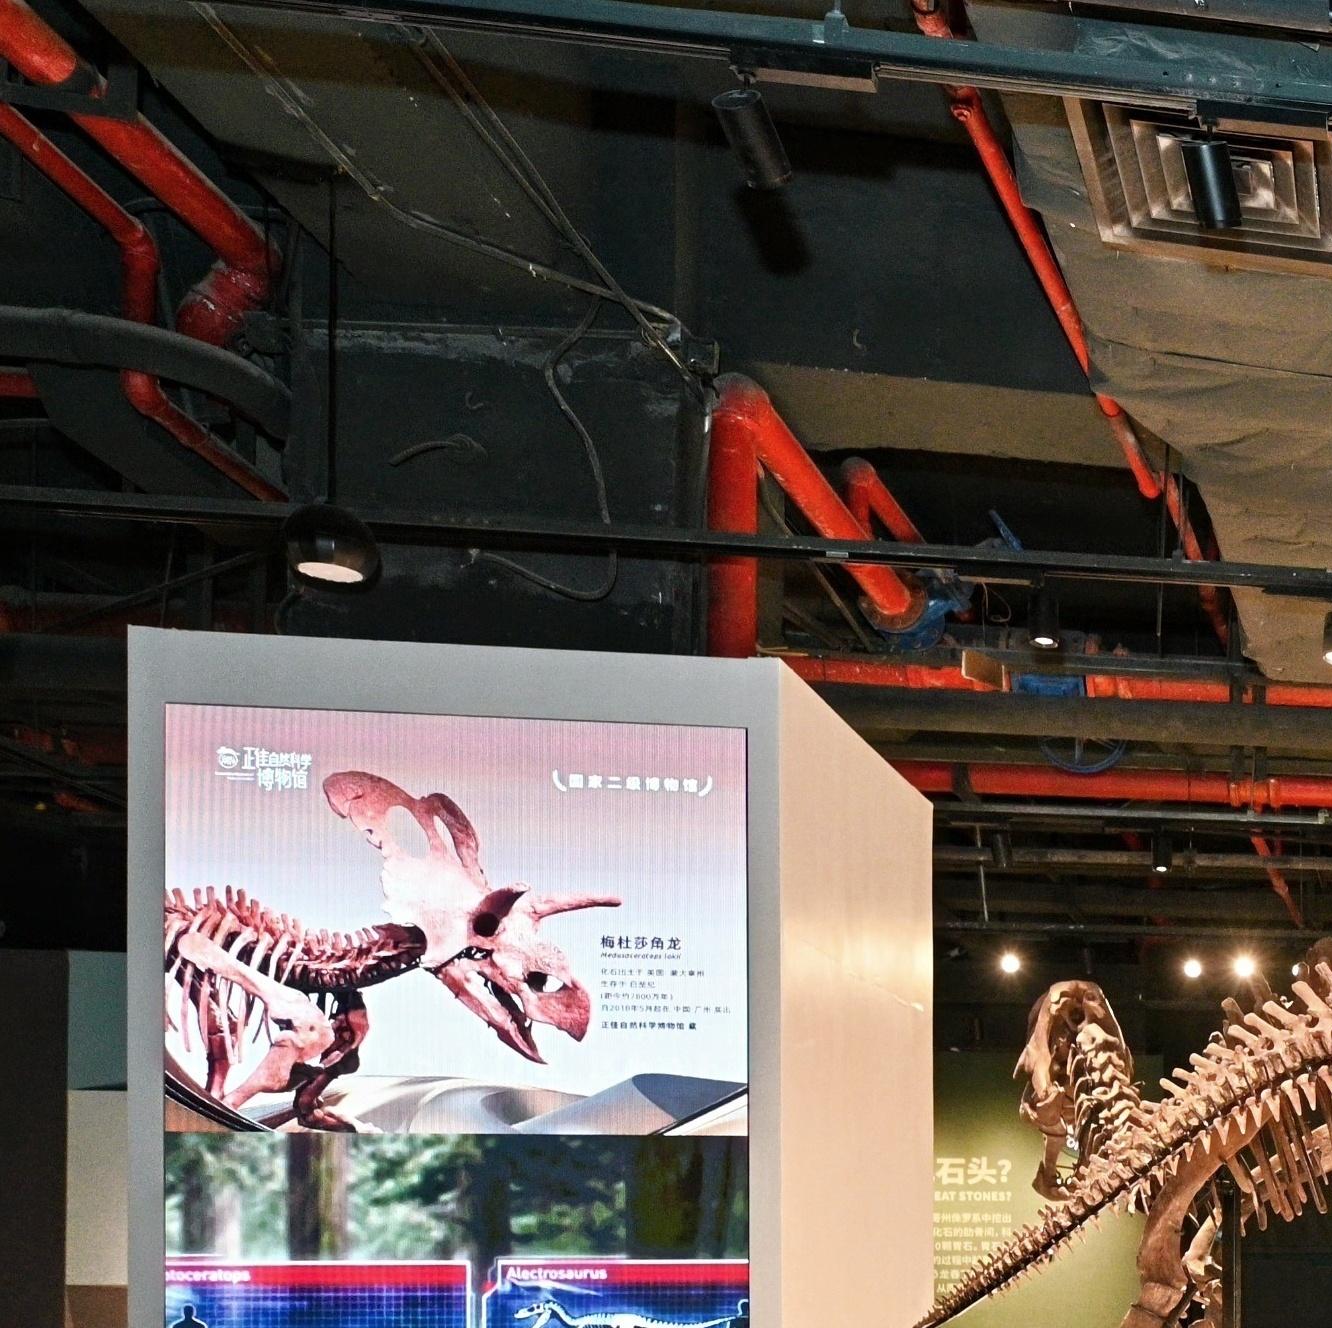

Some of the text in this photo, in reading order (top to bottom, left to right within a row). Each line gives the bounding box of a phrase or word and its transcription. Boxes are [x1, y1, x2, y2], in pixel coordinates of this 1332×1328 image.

[600, 935, 682, 951] 梅杜莎角龙
[934, 1191, 1012, 1201] EAT STONES?
[507, 1266, 608, 1281] Alectrosaurus
